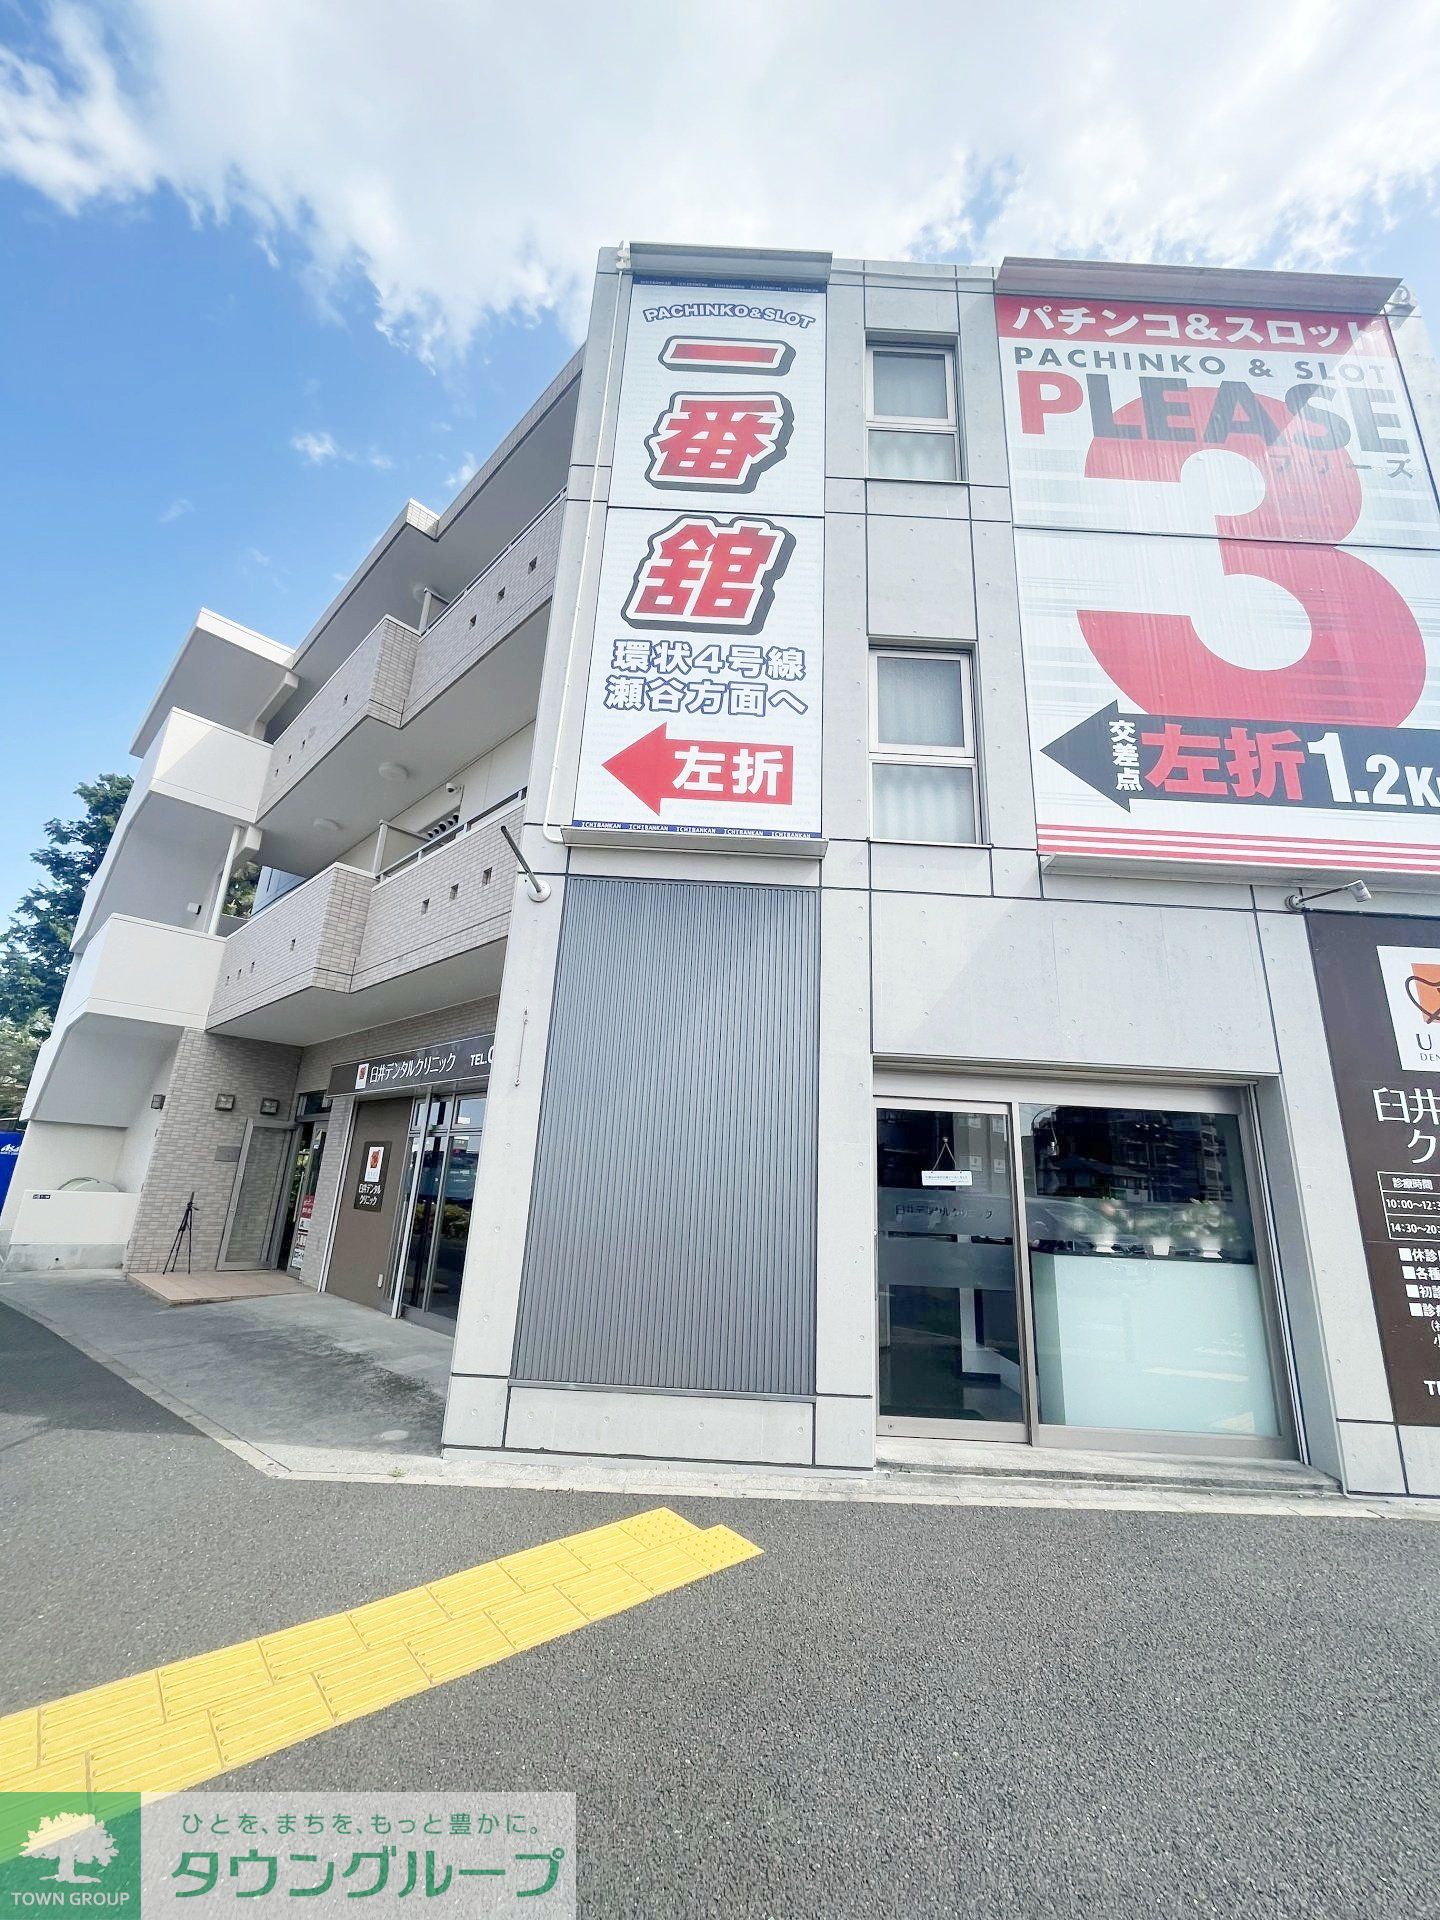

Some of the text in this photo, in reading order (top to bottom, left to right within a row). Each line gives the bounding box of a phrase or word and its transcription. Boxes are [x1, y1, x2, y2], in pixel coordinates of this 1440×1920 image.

[643, 303, 816, 329] PACHINKO&SLOT
[1014, 347, 1388, 384] PACHINKO & SLOT
[1017, 370, 1410, 455] PLEASE
[611, 640, 807, 681] 環状4号線
[604, 676, 808, 717] 瀬谷方面へ
[673, 745, 785, 796] 左折
[1109, 720, 1143, 792] 交差点
[1141, 723, 1440, 808] 左折 1.2K
[369, 1052, 457, 1084] 臼井デンタルクリニック
[1373, 1087, 1440, 1126] 臼井
[1407, 1129, 1437, 1164] ク
[1392, 1177, 1434, 1190] 診療時間
